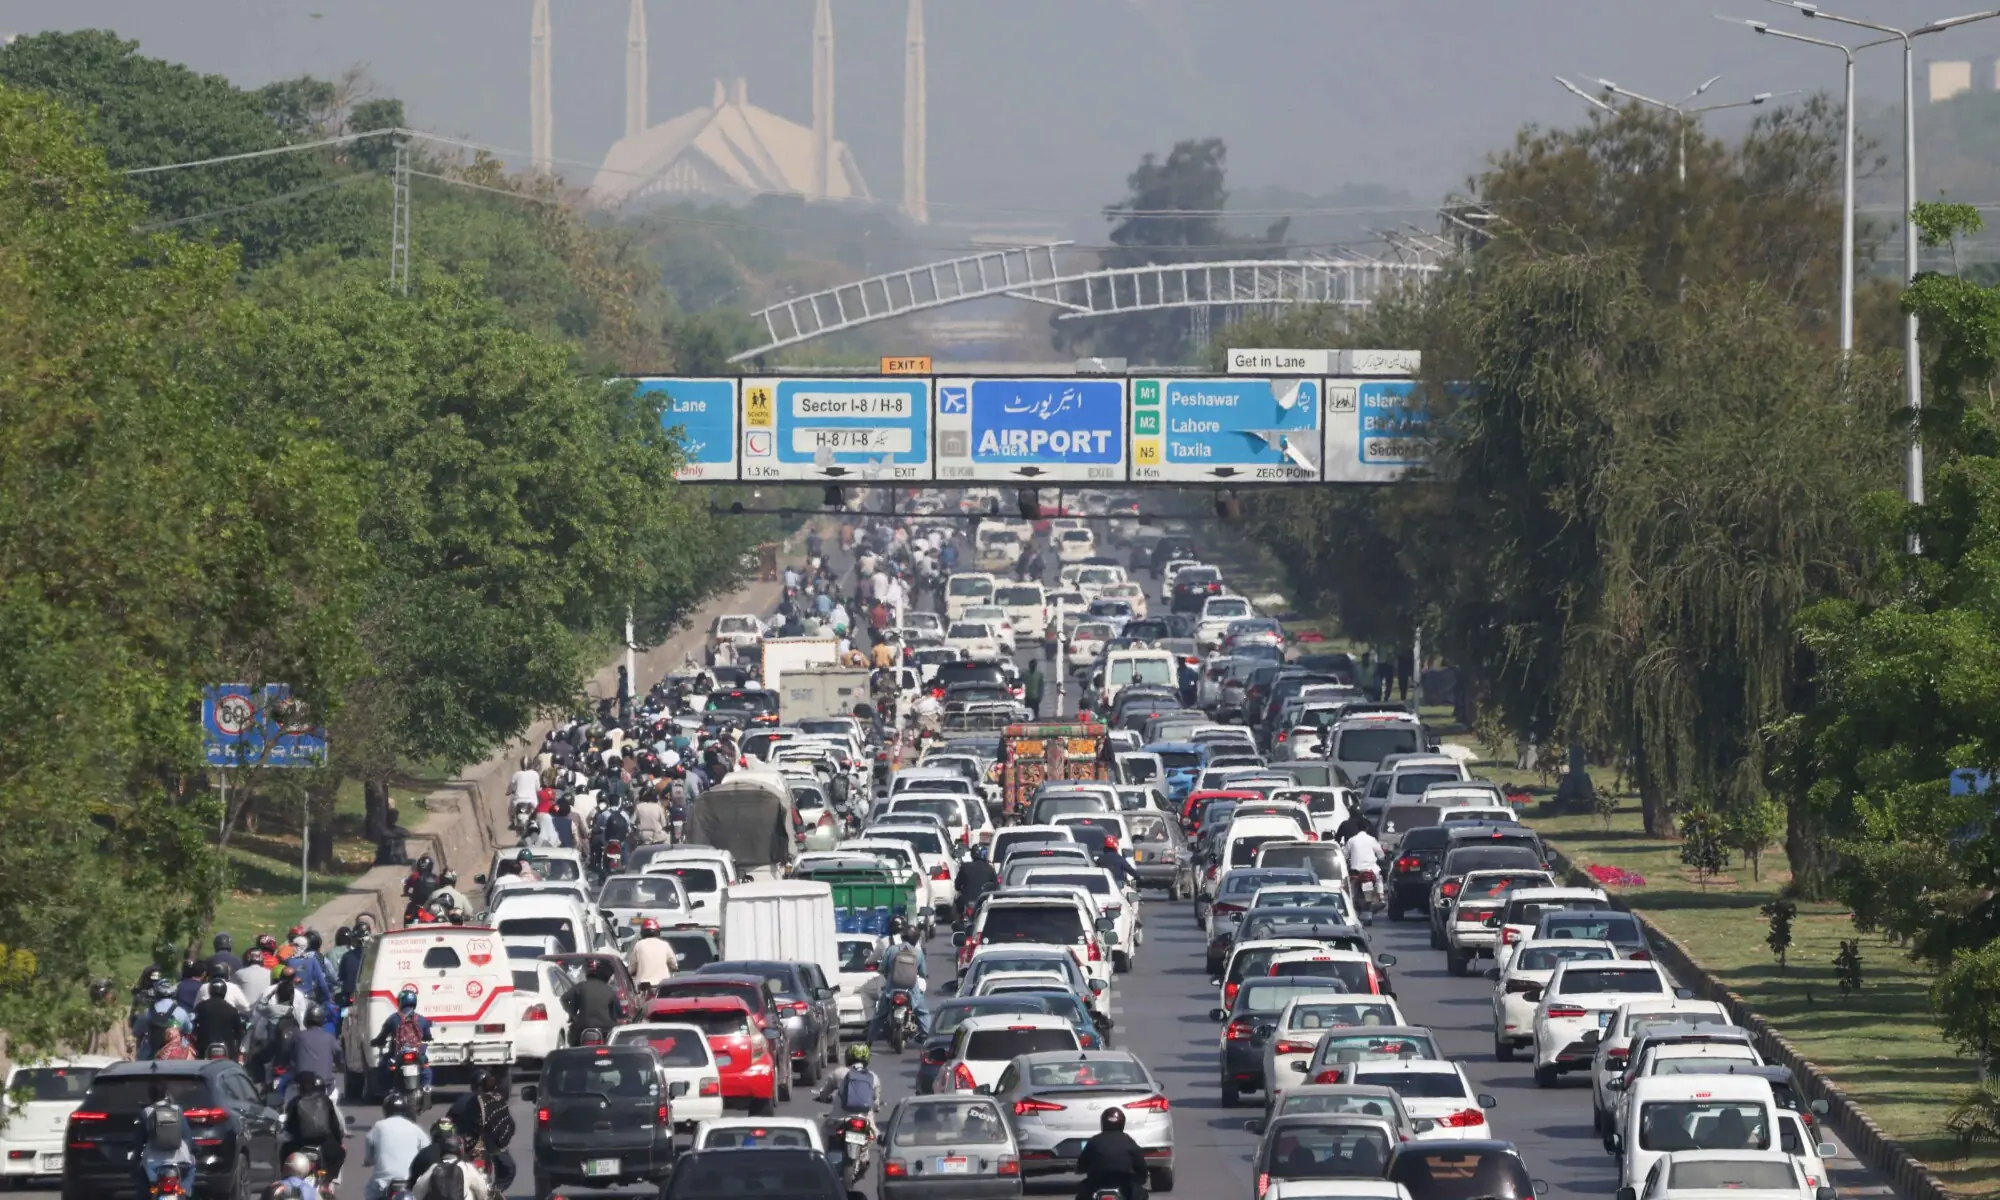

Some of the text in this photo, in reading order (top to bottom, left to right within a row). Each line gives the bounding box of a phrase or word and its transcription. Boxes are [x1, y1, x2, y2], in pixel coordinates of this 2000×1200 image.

[889, 360, 925, 370] EXIT 1
[1235, 354, 1306, 368] Get in Lane
[1140, 387, 1156, 399] M1
[1171, 391, 1240, 406] Peshawar
[672, 398, 707, 412] Lane
[802, 398, 903, 412] Sector I-8 / H-8
[1139, 416, 1156, 429] M2
[1171, 418, 1220, 433] Lahore
[816, 432, 869, 446] H-8 / I-8
[978, 428, 1112, 454] AIRPORT
[1139, 447, 1155, 458] N5
[1171, 442, 1212, 457] Taxila
[1369, 443, 1408, 457] Sector
[681, 465, 704, 477] Only
[747, 467, 780, 476] 1.3 Km
[894, 467, 916, 477] EXIT
[1135, 469, 1160, 477] 4 Km
[1256, 468, 1316, 478] ZERO POINT
[969, 1109, 997, 1123] DON
